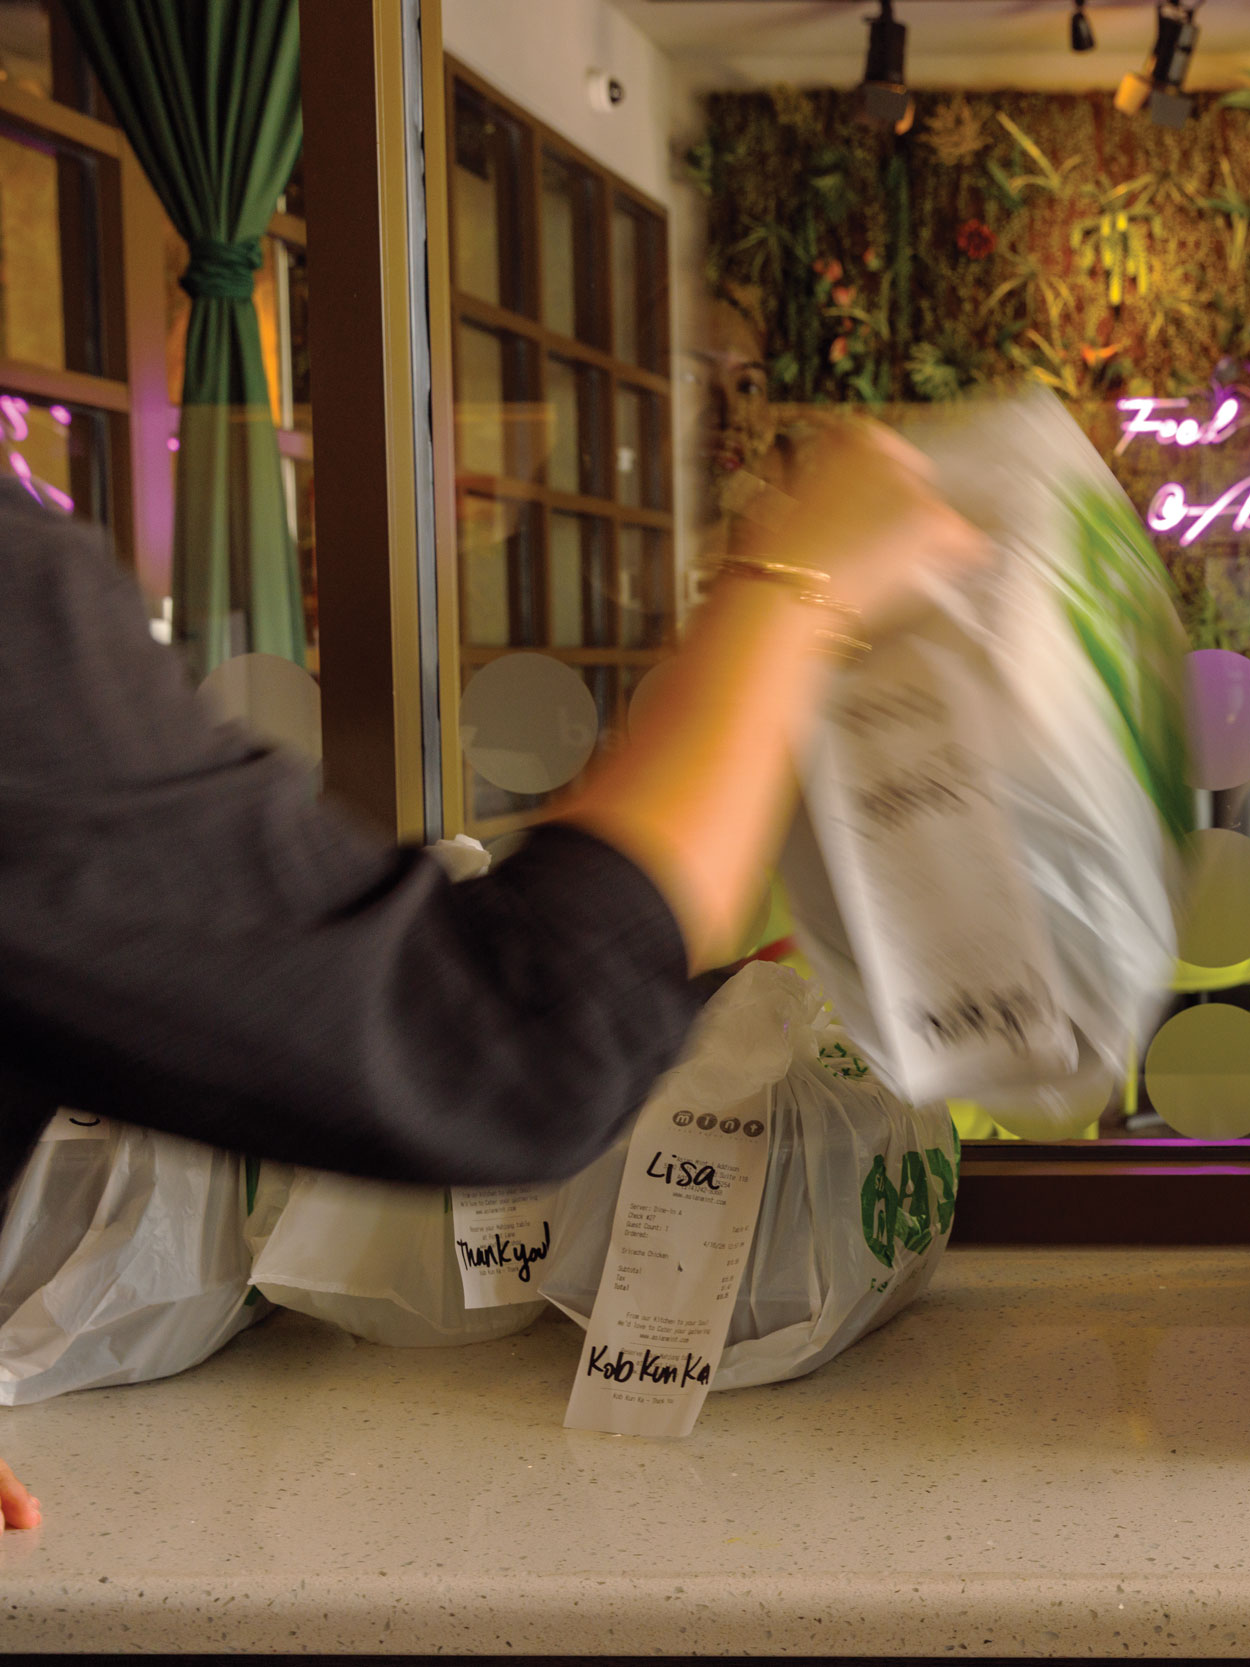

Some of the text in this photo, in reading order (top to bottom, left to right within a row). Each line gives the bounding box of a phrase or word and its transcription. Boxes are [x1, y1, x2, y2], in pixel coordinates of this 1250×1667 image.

[646, 1152, 720, 1190] Lisa
[456, 1233, 512, 1271] Thank
[587, 1344, 634, 1383] Kob
